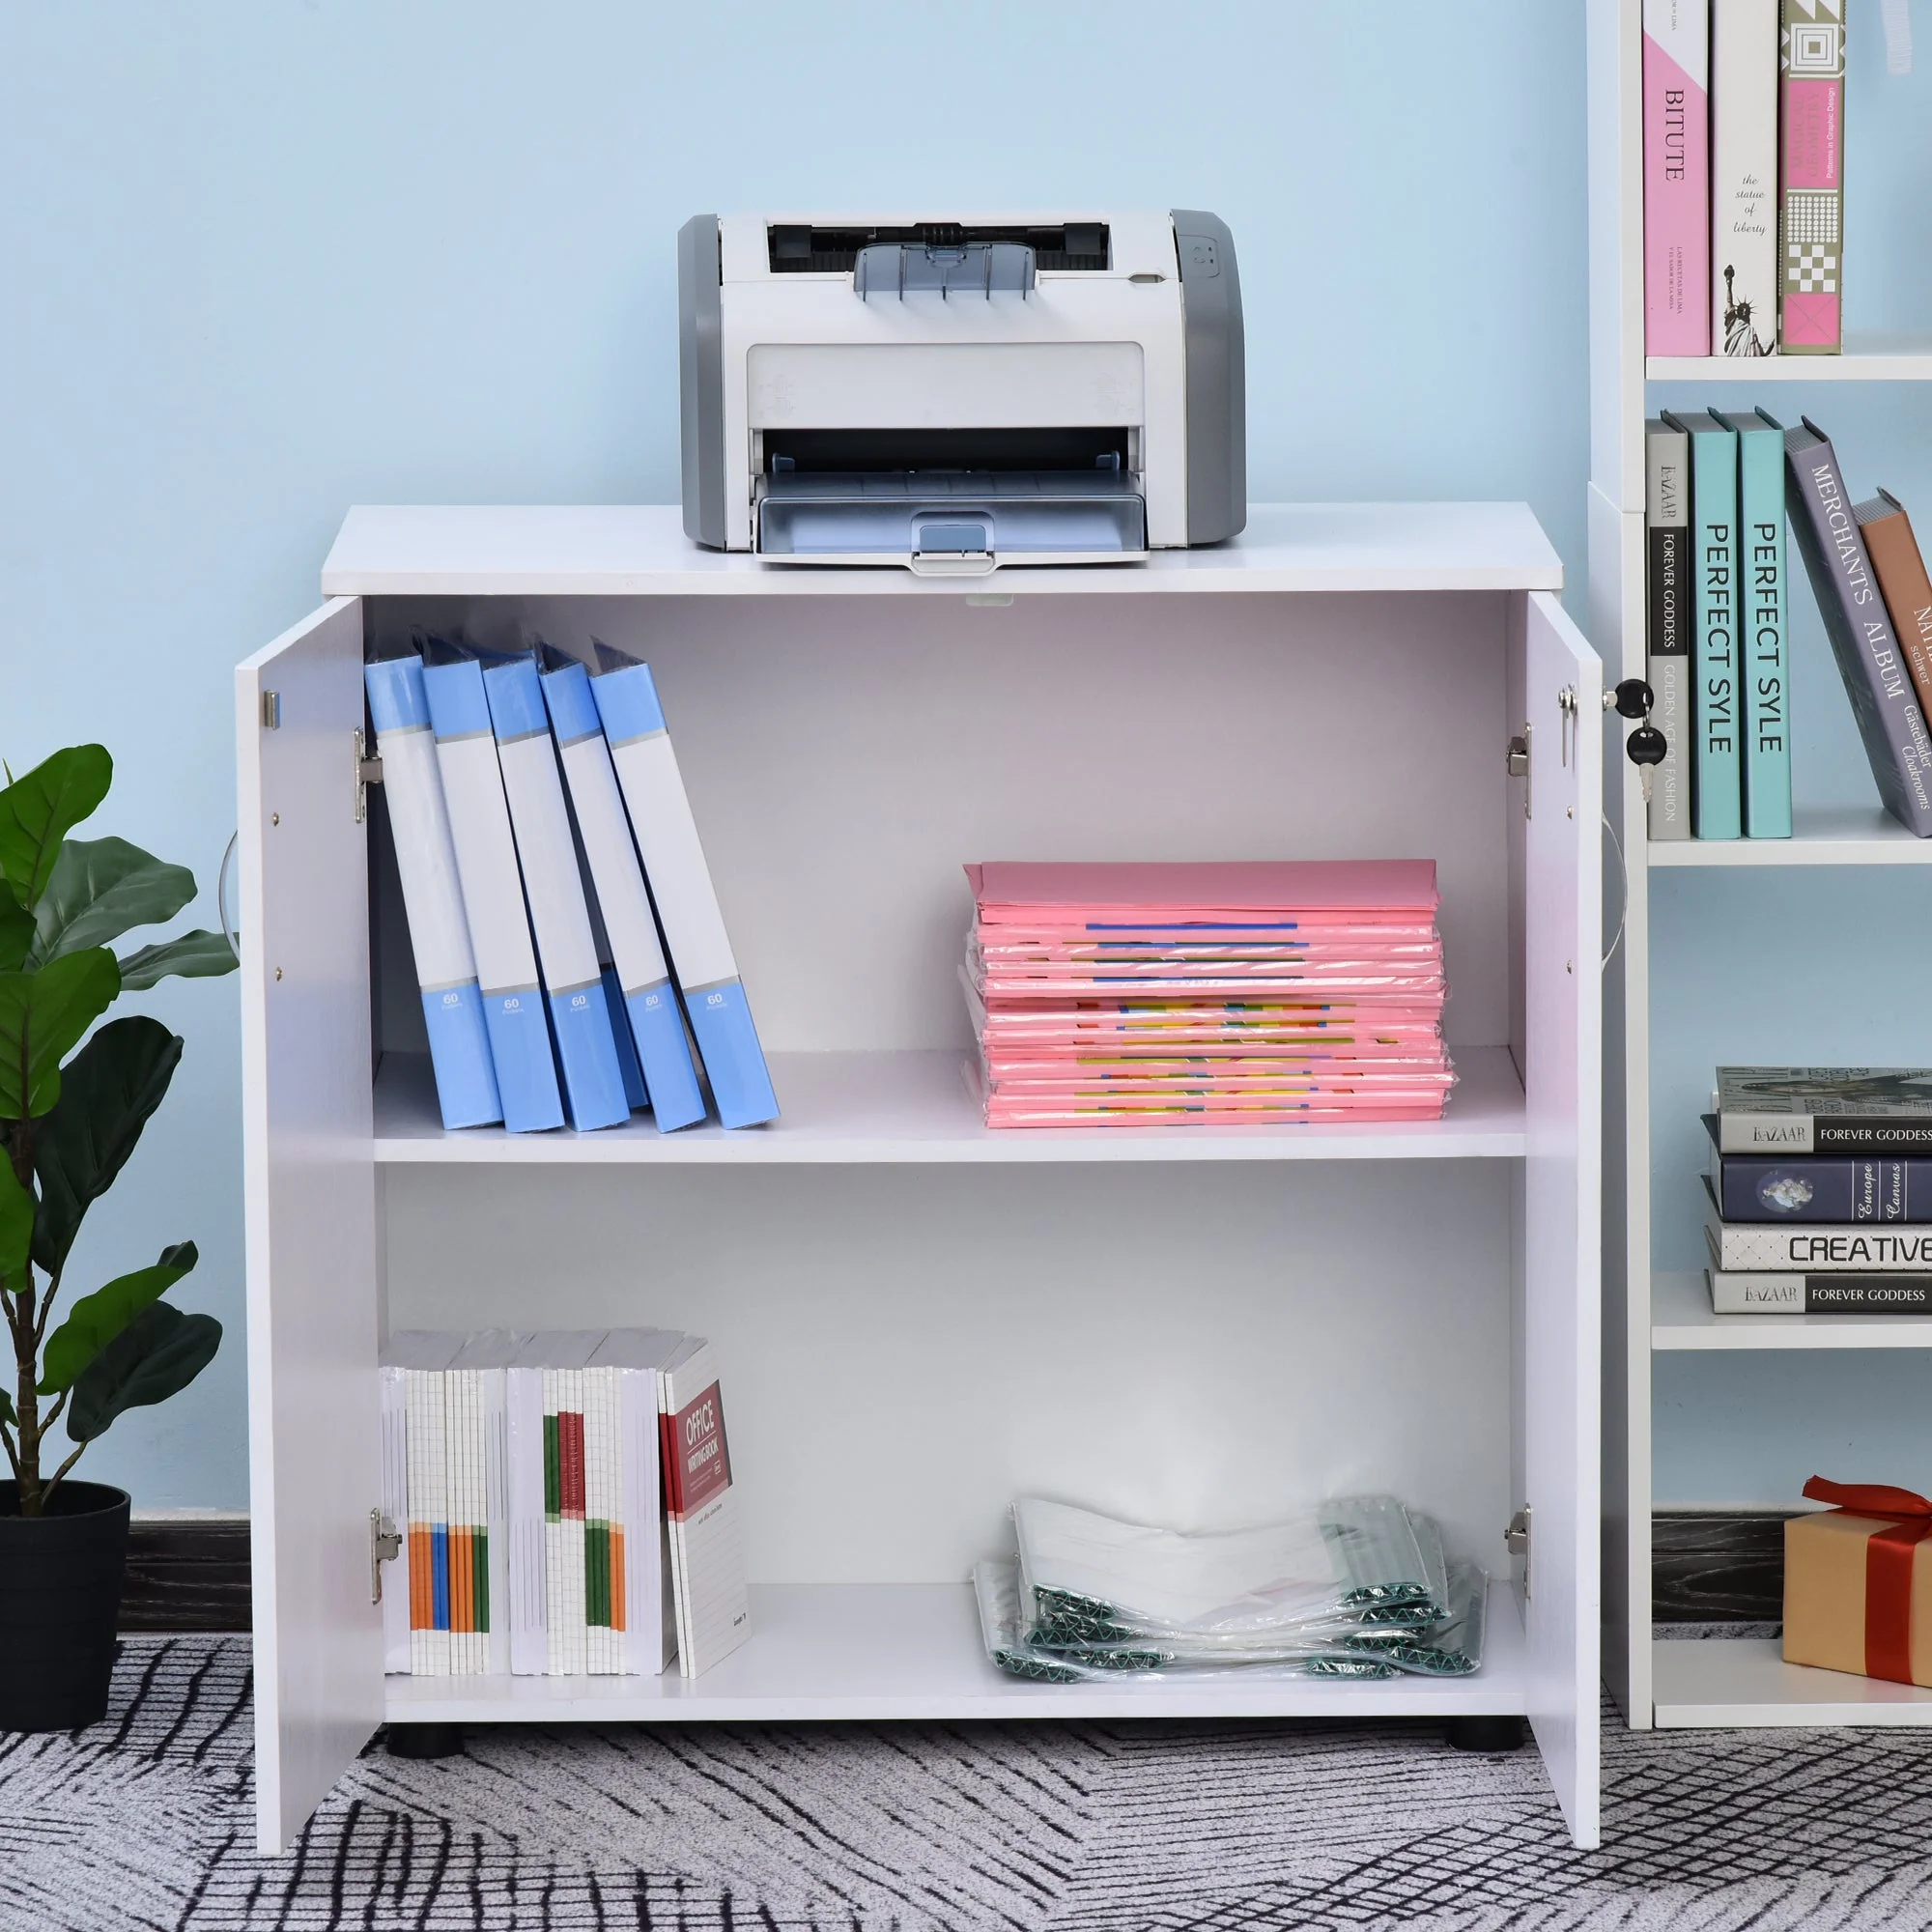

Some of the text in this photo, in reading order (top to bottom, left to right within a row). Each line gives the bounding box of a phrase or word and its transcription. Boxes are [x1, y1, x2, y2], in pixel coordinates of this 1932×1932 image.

[1826, 87, 1835, 112] Design
[1664, 89, 1685, 181] BITUTE
[1826, 113, 1835, 141] Graphic
[1826, 150, 1834, 179] Patterns
[1742, 174, 1759, 185] the
[1735, 189, 1766, 199] statue
[1744, 203, 1756, 216] of
[1733, 222, 1767, 237] liberty
[1661, 466, 1676, 519] BAZAAR
[1662, 533, 1675, 648] FOREVER GODDESS
[1811, 464, 1905, 699] MERCHANTS ALBUM
[1706, 525, 1731, 753] PERFECT SYLE
[1753, 524, 1781, 753] PERFECT SYLE
[1910, 645, 1930, 685] schwer
[1664, 665, 1676, 821] GOLDEN AGE OF FASHION
[1903, 705, 1932, 769] Gästebäder
[1901, 746, 1930, 810] Cloakrooms
[443, 993, 459, 1004] 60
[504, 998, 519, 1009] 60
[572, 995, 586, 1007] 60
[645, 995, 659, 1006] 60
[707, 993, 723, 1005] 60
[1752, 1126, 1805, 1142] BAZAAR
[1821, 1129, 1932, 1141] FOREVER GODDESS
[1858, 1163, 1877, 1219] Europe
[1887, 1163, 1901, 1219] Canvas
[1789, 1236, 1932, 1262] CREATIVE
[1745, 1287, 1798, 1302] BAZAAR
[1812, 1290, 1925, 1301] FOREVER GODDESS
[686, 1399, 715, 1446] OFFICE
